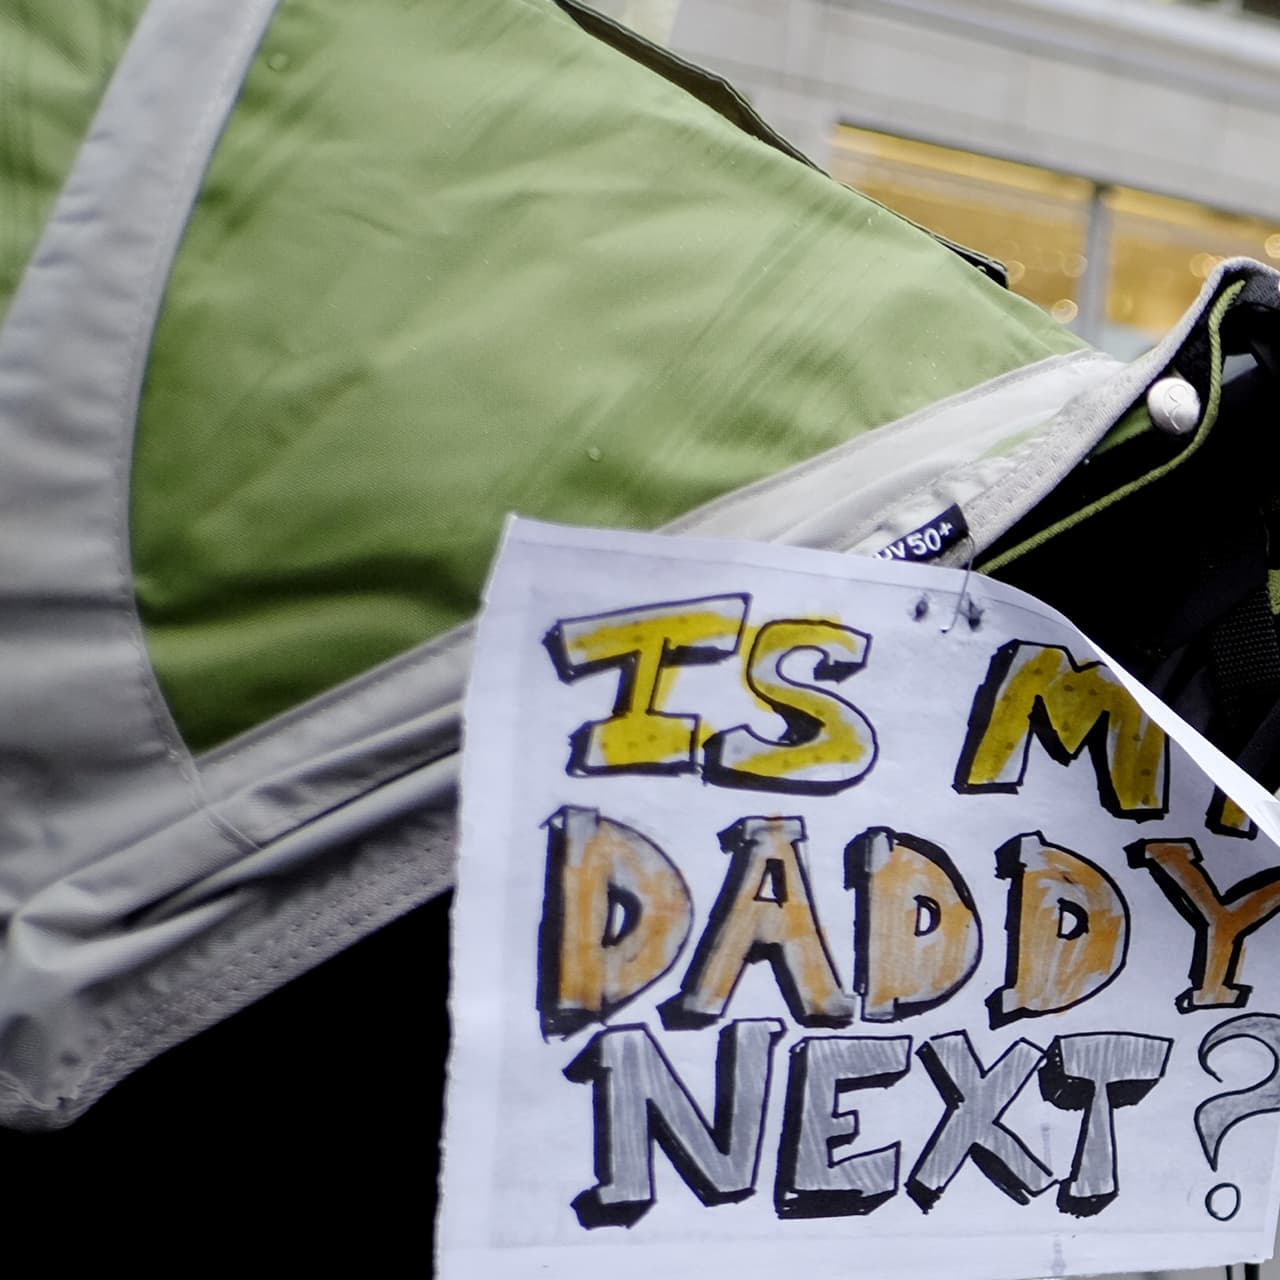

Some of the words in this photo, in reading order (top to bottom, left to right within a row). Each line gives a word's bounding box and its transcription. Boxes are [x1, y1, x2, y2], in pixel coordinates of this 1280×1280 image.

[906, 520, 953, 556] 50+
[543, 592, 878, 796] IS
[953, 639, 1256, 839] M
